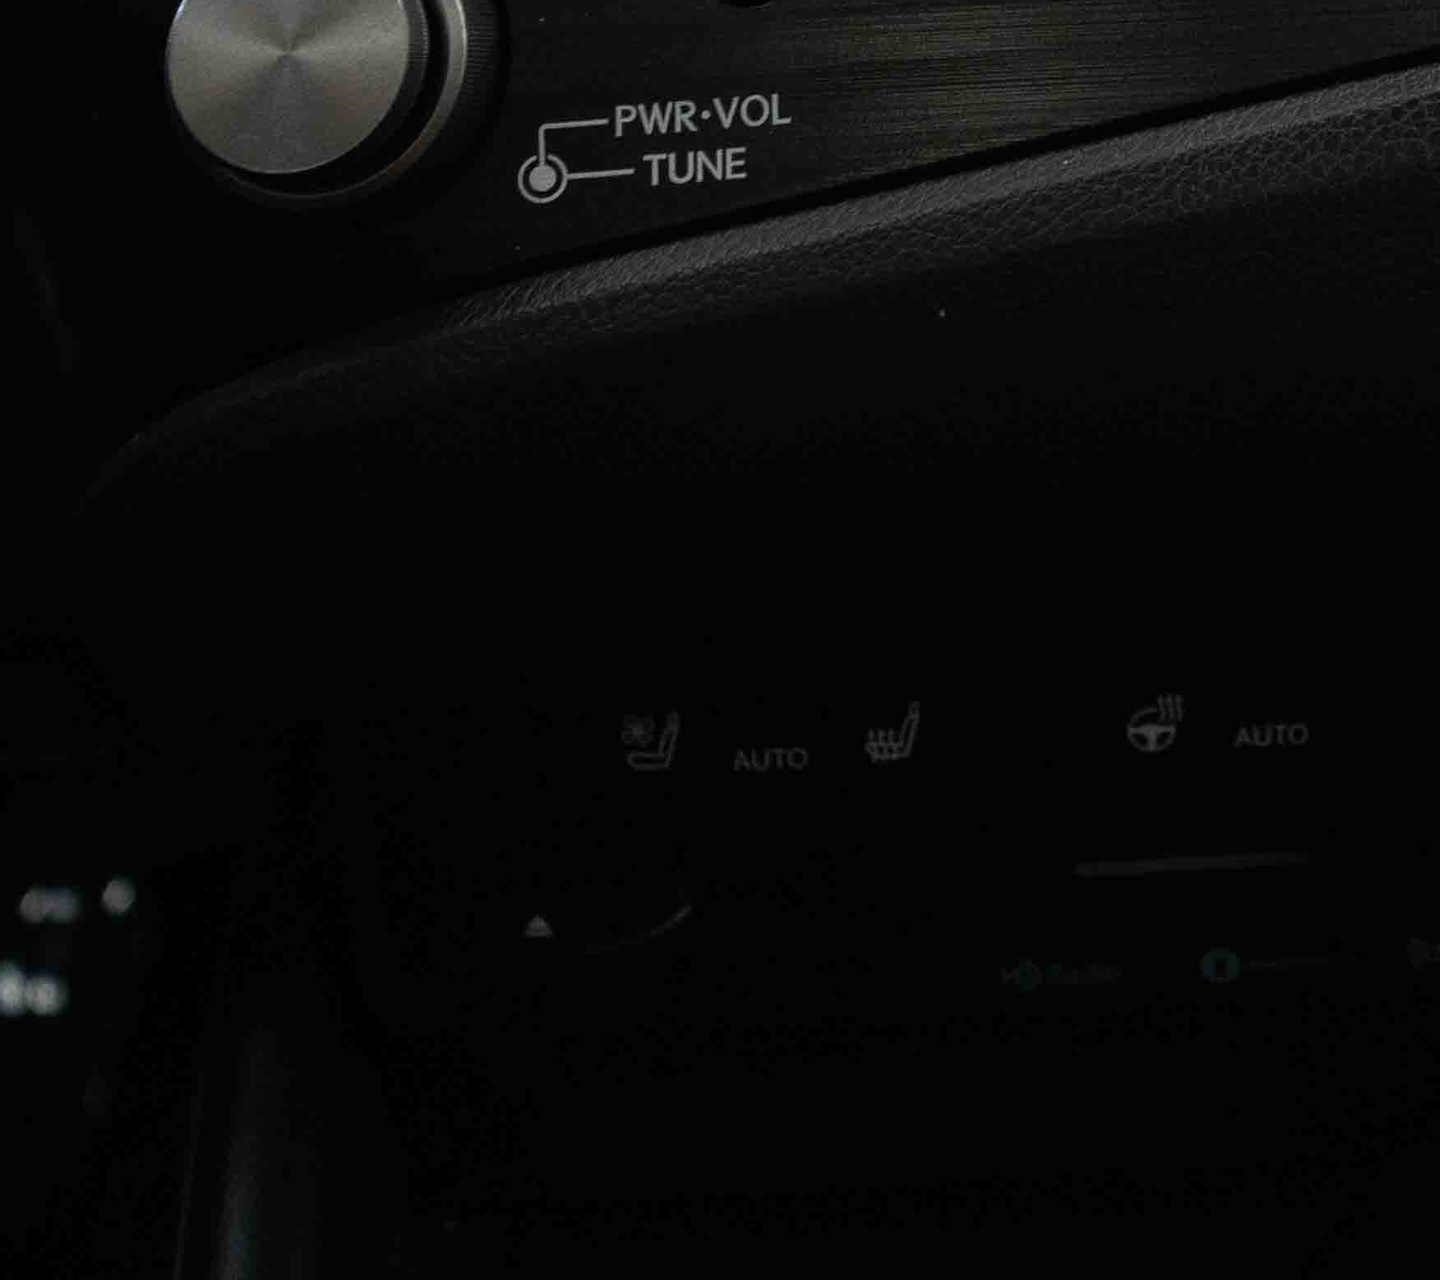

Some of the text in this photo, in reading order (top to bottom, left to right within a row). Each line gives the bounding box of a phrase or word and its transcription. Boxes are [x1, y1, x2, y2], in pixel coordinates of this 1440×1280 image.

[642, 146, 748, 186] TUNE
[1233, 723, 1309, 747] AUTO
[733, 746, 809, 772] AUTO
